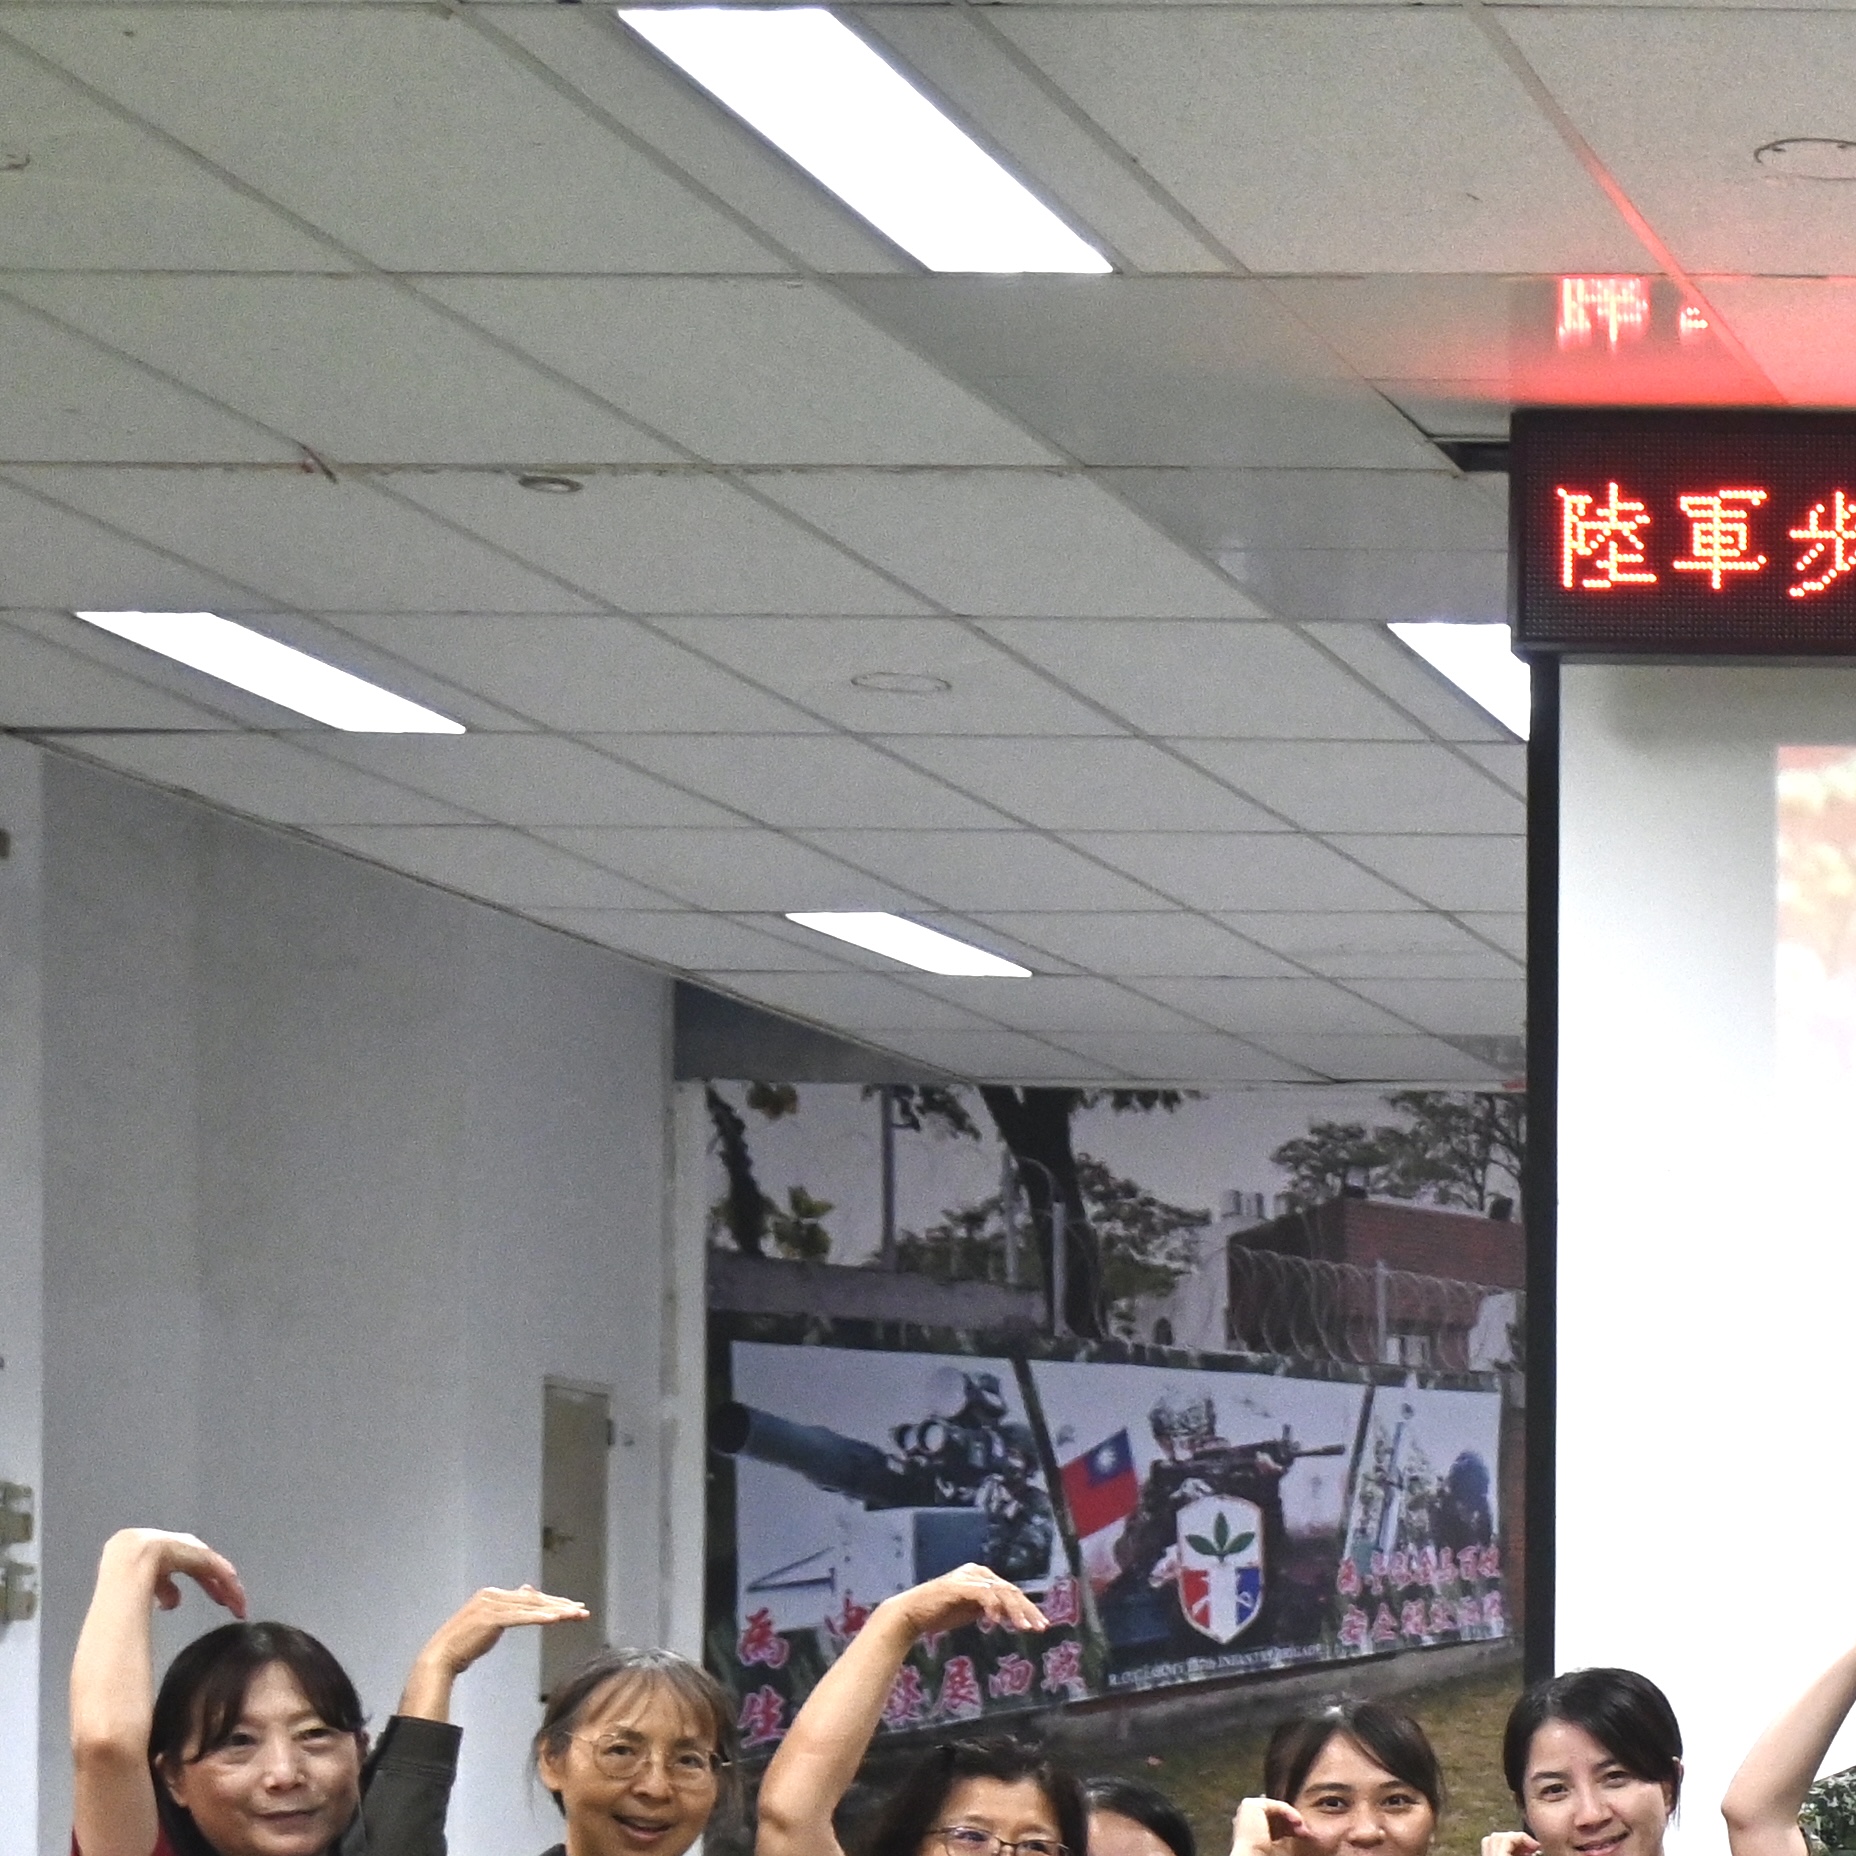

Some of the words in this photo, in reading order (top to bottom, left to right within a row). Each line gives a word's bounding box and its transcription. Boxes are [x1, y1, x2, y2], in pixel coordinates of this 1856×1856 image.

[737, 1640, 1087, 1749] 生發展而戰
